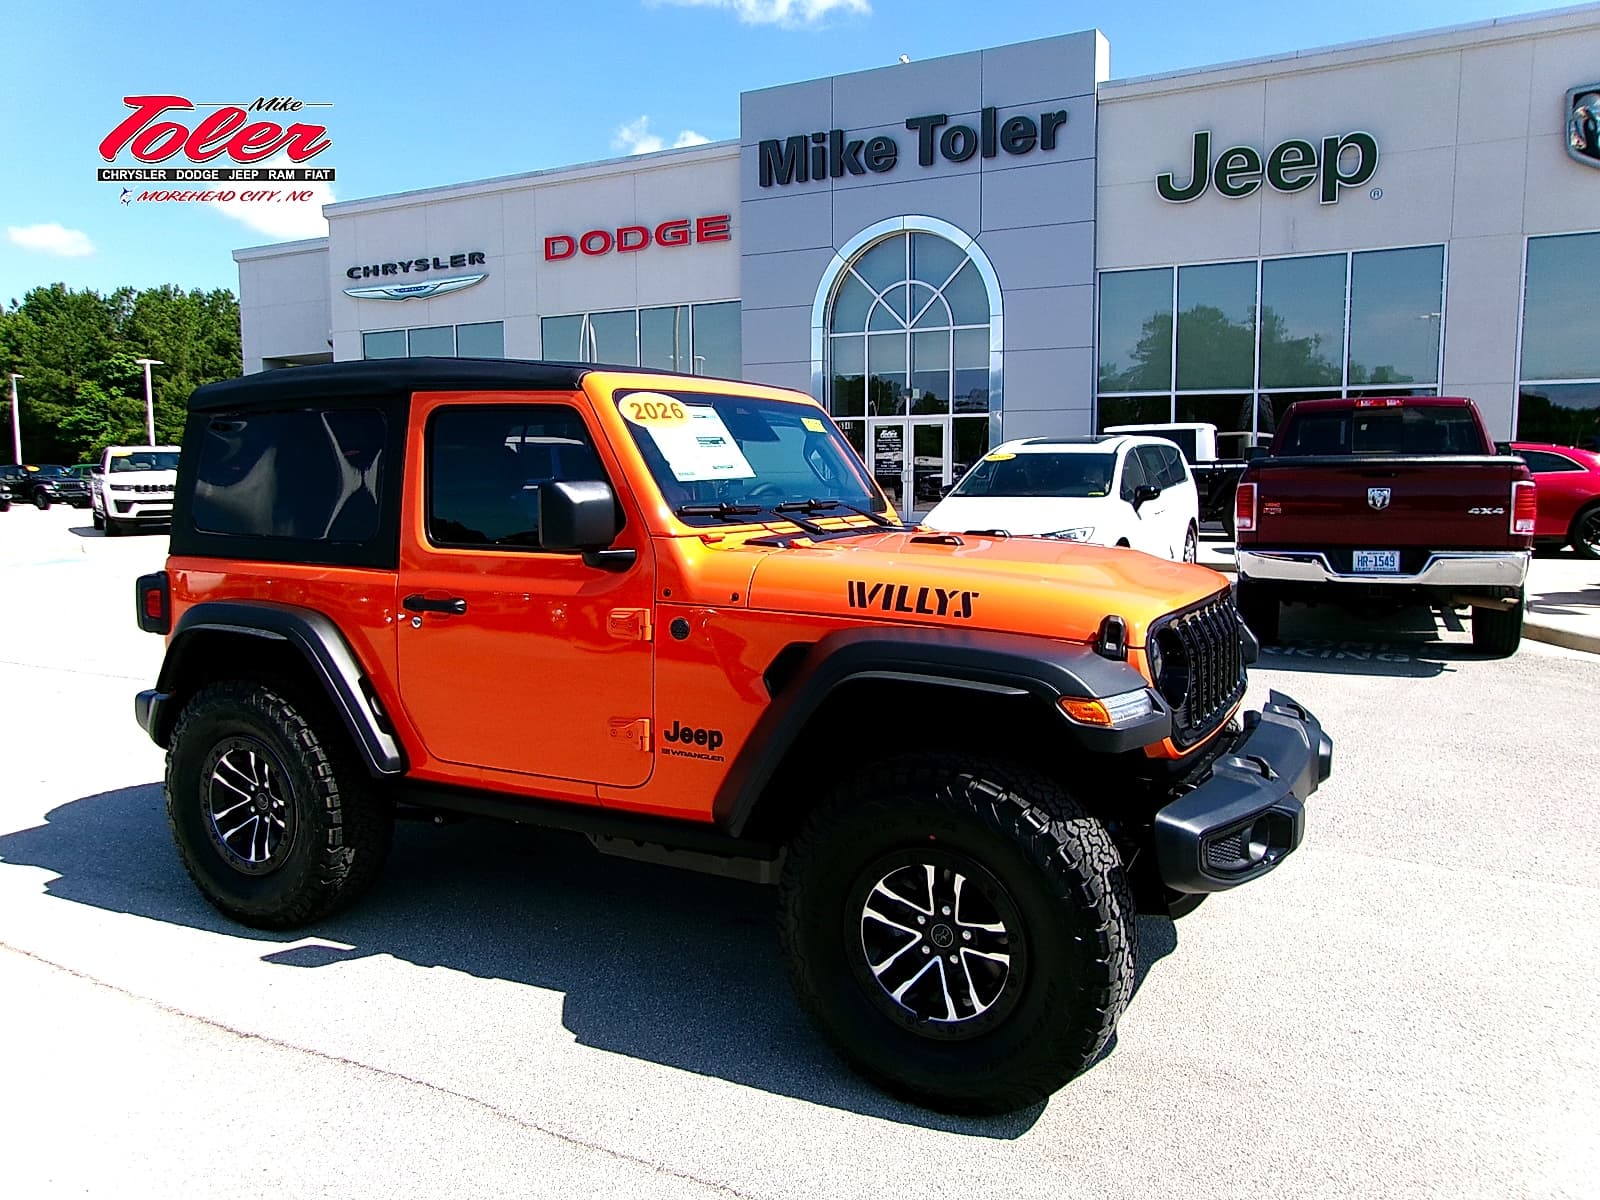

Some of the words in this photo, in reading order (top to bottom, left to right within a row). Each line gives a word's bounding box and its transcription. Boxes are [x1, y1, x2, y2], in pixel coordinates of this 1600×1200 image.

[758, 129, 898, 187] Mike
[905, 106, 1068, 167] Toler
[1155, 129, 1379, 205] Jeep
[544, 213, 731, 262] DODGE
[345, 251, 486, 280] CHRYSLER
[629, 402, 684, 420] 2026
[1357, 555, 1396, 567] HR-1549
[847, 580, 980, 619] WILLYS
[663, 720, 724, 752] Jeep
[671, 749, 725, 762] WRANGLER
